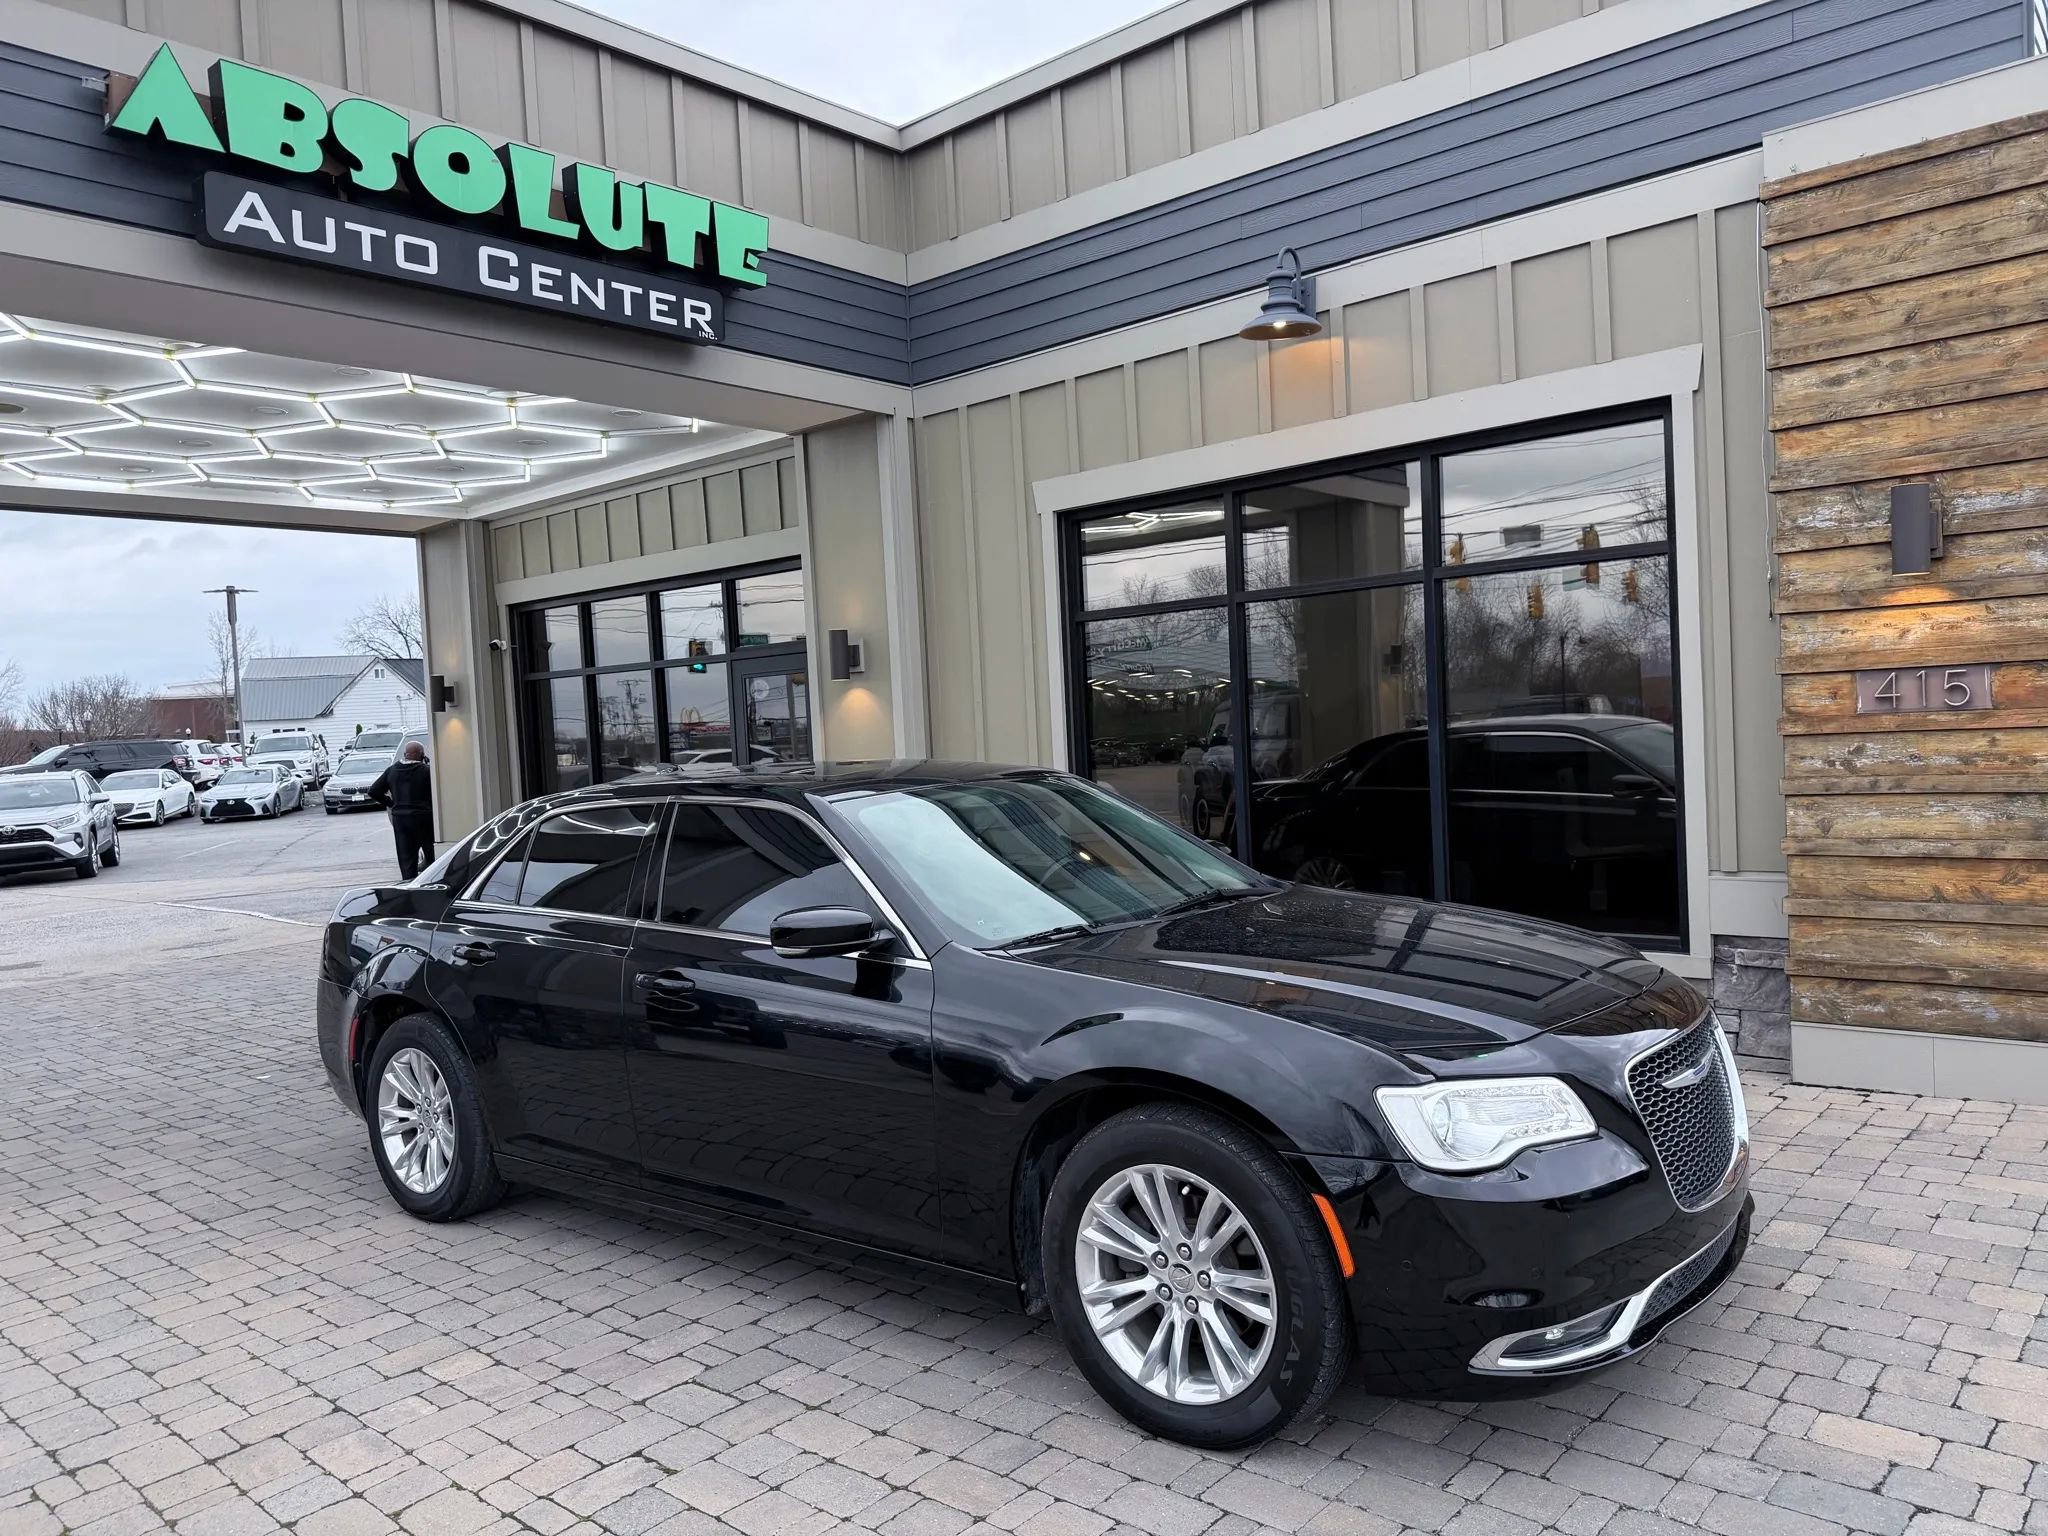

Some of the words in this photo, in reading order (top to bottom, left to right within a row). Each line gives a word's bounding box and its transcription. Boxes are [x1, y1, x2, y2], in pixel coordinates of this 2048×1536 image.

[107, 41, 769, 288] ABSOLUTE
[698, 330, 718, 341] INC.
[1874, 669, 1971, 708] 415
